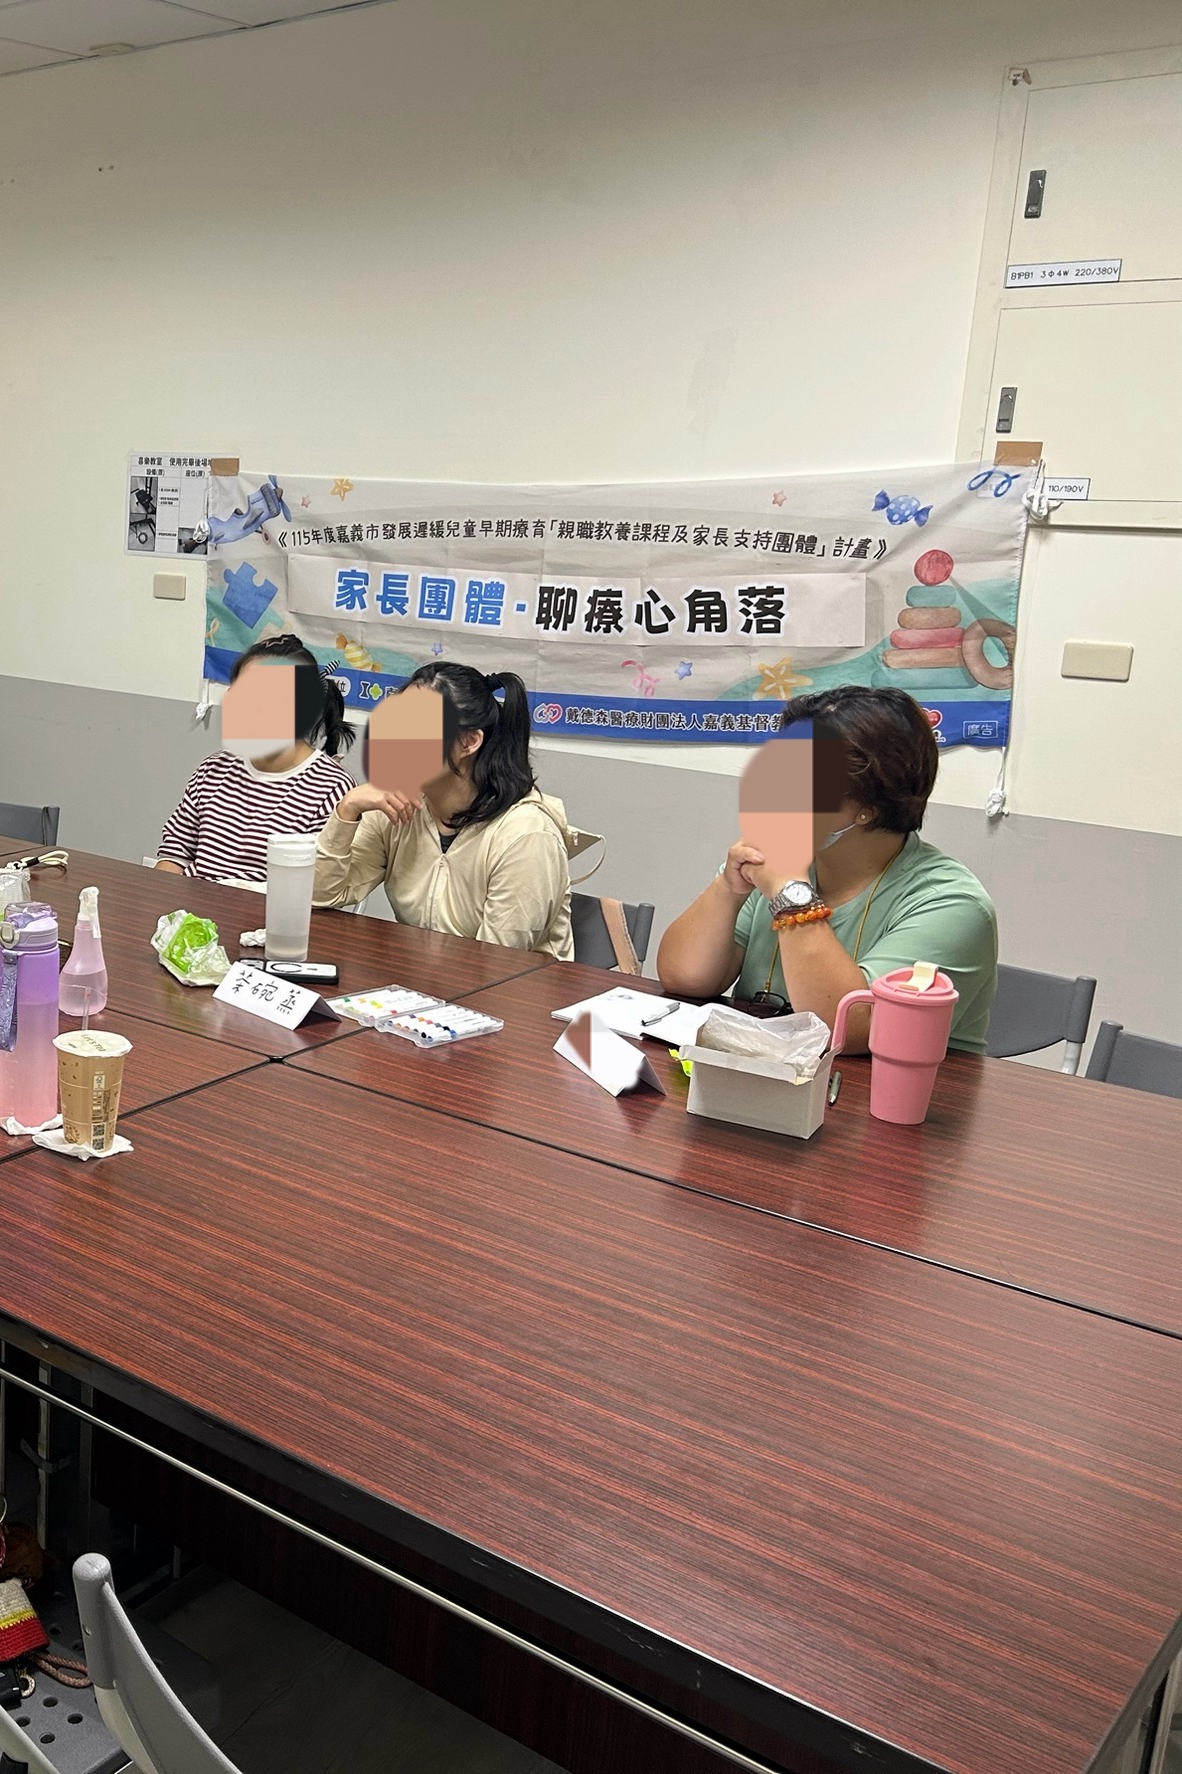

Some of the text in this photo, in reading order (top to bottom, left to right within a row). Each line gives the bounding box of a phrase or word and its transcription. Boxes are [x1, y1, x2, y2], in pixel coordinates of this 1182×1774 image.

[1075, 266, 1119, 277] 220/380V
[1048, 484, 1084, 493] 110/190V
[967, 723, 994, 736] 廣告
[231, 970, 301, 1015] 茶碗蒸
